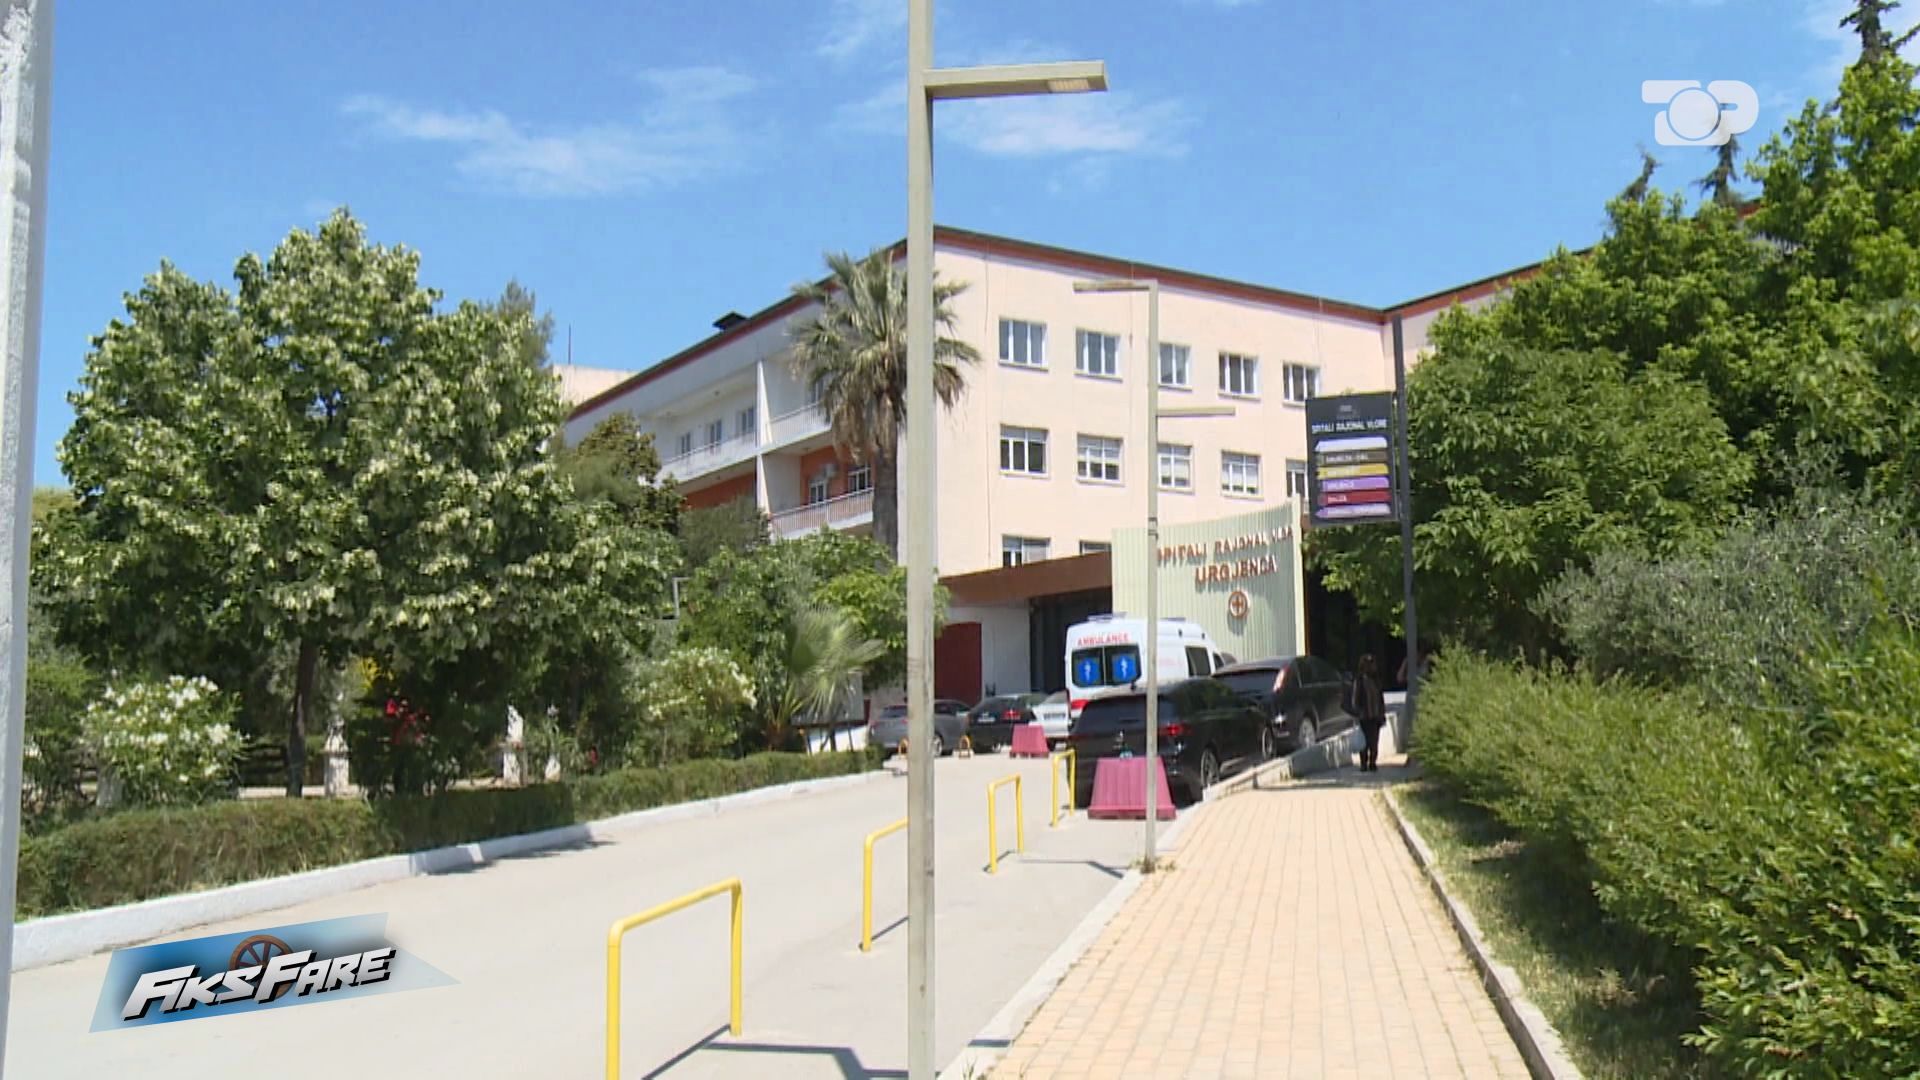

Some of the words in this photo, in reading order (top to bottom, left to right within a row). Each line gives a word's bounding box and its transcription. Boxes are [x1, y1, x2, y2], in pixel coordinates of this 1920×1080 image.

[1215, 532, 1268, 553] RAJONAL
[1195, 555, 1277, 583] URGJENCA
[1077, 633, 1129, 646] AMBULANCE
